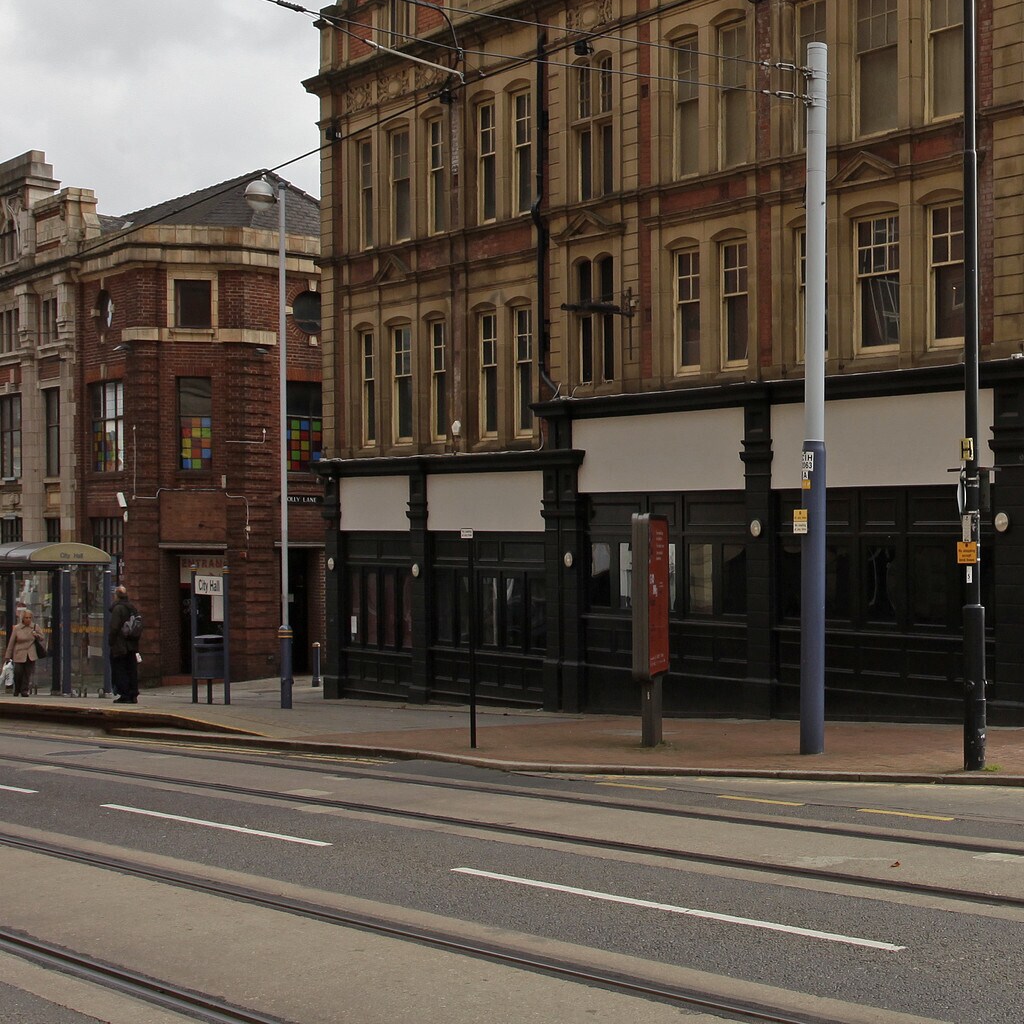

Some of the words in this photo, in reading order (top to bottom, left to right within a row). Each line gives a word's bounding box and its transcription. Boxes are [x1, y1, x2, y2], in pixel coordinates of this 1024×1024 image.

[961, 440, 972, 458] H
[181, 558, 223, 568] ENTRAN
[198, 579, 208, 593] City
[209, 580, 221, 592] Hall
